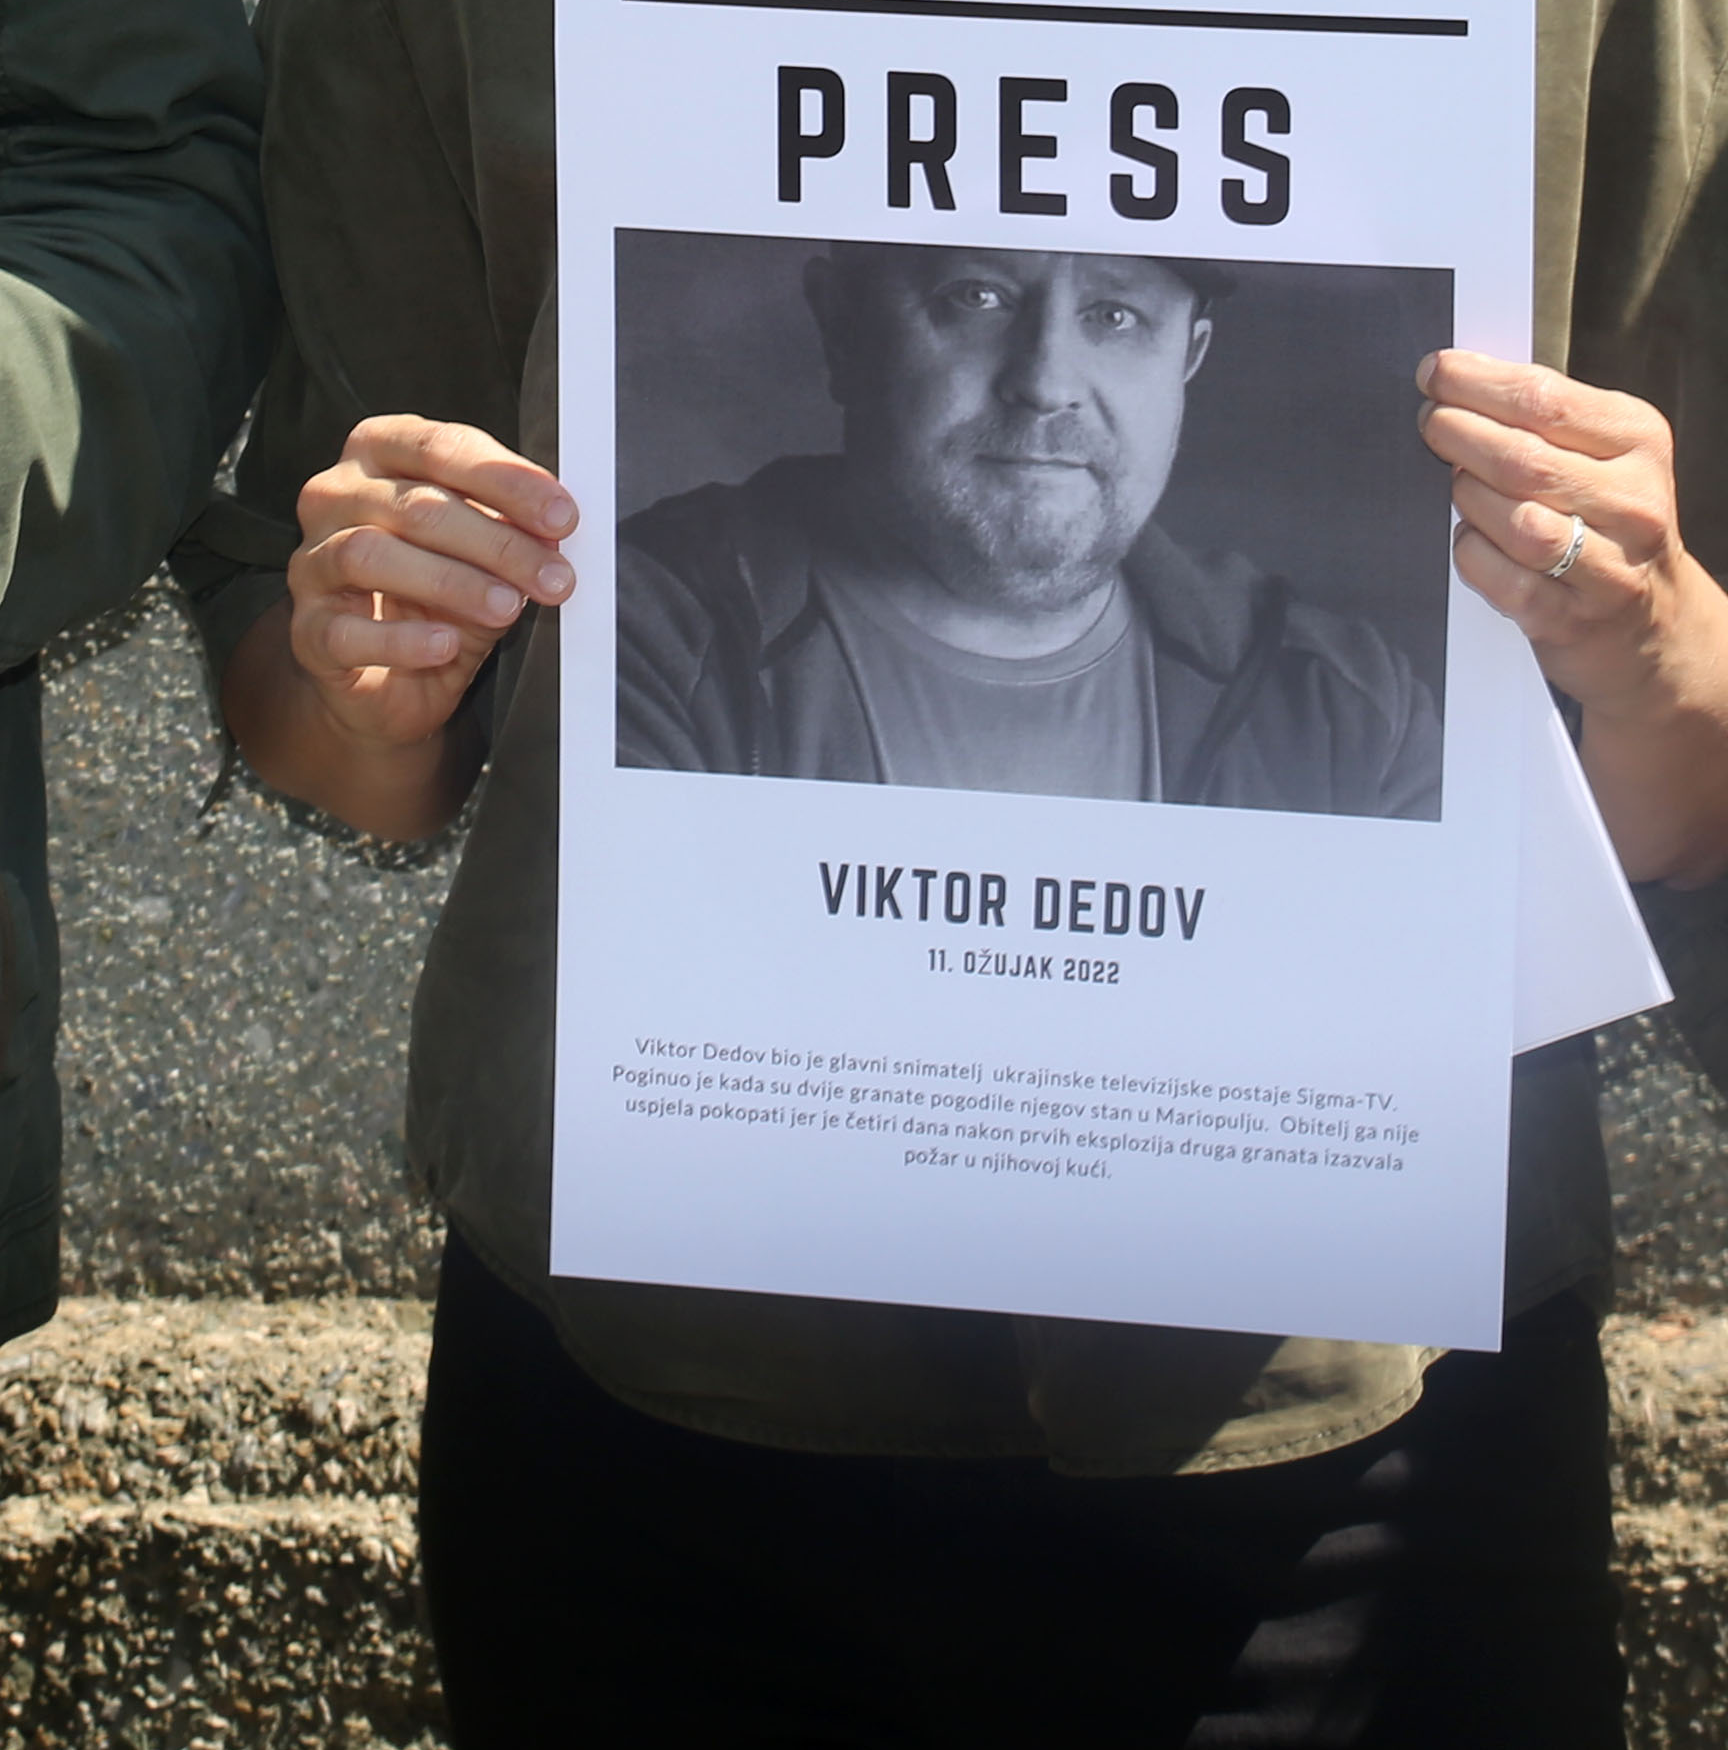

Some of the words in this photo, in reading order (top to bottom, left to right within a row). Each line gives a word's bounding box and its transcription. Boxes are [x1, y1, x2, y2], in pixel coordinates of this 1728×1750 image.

[777, 65, 1291, 226] PRESS
[818, 861, 1008, 928] VIKTOR
[1033, 876, 1206, 942] DEDOV
[927, 948, 954, 973] 11.
[963, 948, 1054, 981] OŽUJAK
[1063, 957, 1120, 985] 2022
[612, 1064, 692, 1089] Poginuo
[694, 1070, 714, 1093] je
[719, 1071, 766, 1094] kada
[769, 1080, 792, 1096] su
[796, 1078, 845, 1103] dvije
[849, 1086, 926, 1106] granate
[930, 1092, 1016, 1113] pogodile
[1020, 1096, 1087, 1120] njegov
[1090, 1102, 1133, 1122] stan
[1137, 1108, 1150, 1123] u
[1155, 1105, 1270, 1135] Mariopulju.
[1279, 1115, 1350, 1142] Obitelj
[1354, 1125, 1378, 1144] ga
[1382, 1123, 1420, 1147] nije
[634, 1037, 699, 1059] Viktor
[702, 1041, 767, 1064] Dedov
[770, 1046, 803, 1067] bio
[804, 1049, 826, 1072] je
[828, 1051, 888, 1074] glavni
[892, 1057, 983, 1085] snimatelj
[992, 1064, 1096, 1090] ukrajinske
[1100, 1073, 1214, 1100] televizijske
[1218, 1085, 1292, 1107] postaje
[1296, 1086, 1398, 1113] Sigma-TV.
[625, 1096, 695, 1119] uspjela
[699, 1101, 785, 1126] pokopati
[788, 1106, 818, 1129] jer
[820, 1109, 841, 1131] je
[844, 1110, 898, 1133] četiri
[902, 1116, 950, 1137] dana
[954, 1121, 1015, 1142] nakon
[1019, 1127, 1071, 1147] prvih
[1075, 1129, 1175, 1158] eksplozija
[1179, 1137, 1237, 1162] druga
[1241, 1146, 1319, 1166] granata
[1323, 1147, 1404, 1172] izazvala
[903, 1146, 961, 1167] požar
[964, 1153, 977, 1169] u
[981, 1151, 1061, 1179] njihovoj
[1065, 1157, 1113, 1180] kući.
